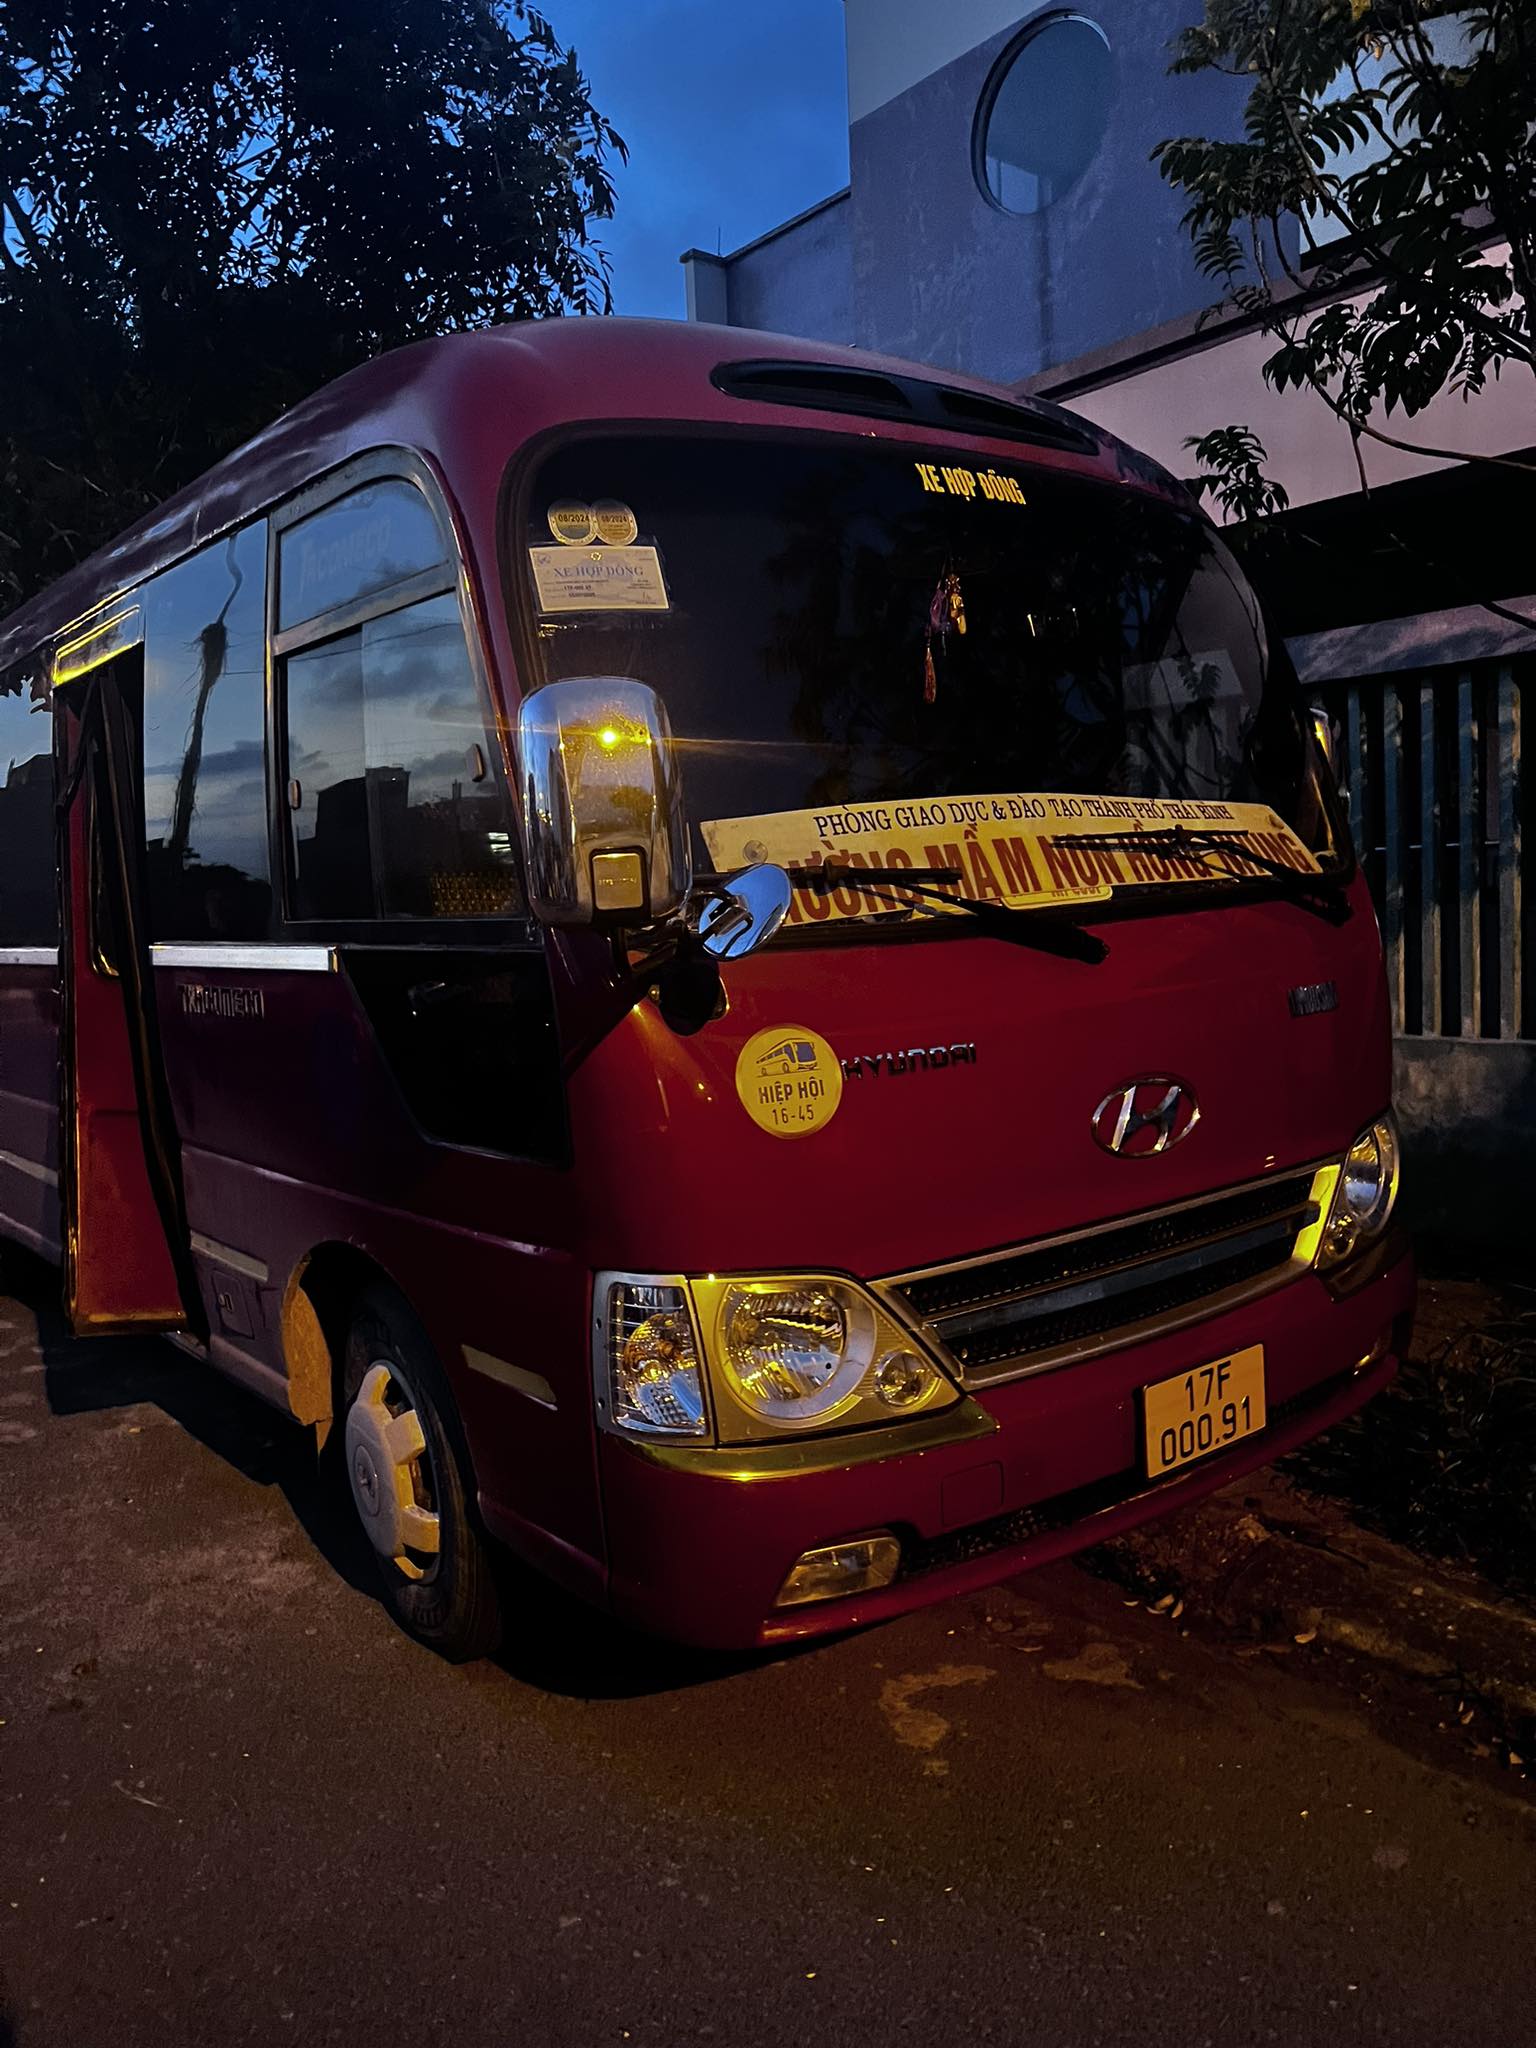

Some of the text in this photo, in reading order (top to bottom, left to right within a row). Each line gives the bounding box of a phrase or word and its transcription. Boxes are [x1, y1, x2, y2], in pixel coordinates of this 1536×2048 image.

[914, 463, 945, 493] XE
[940, 466, 976, 501] HỢP
[554, 567, 573, 577] XE
[813, 805, 892, 837] PHÒNG
[894, 804, 947, 829] GIAO
[947, 799, 989, 825] DỤC
[992, 800, 1007, 821] &
[1006, 795, 1046, 819] ĐÀO
[1049, 798, 1083, 820] TẠO
[1082, 796, 1137, 818] THÀNH
[1131, 799, 1166, 819] PHỐ
[1162, 800, 1199, 820] THÁI
[841, 1043, 977, 1081] HYUNDAI
[758, 1079, 825, 1105] HIỆP HỘI
[771, 1104, 815, 1125] 16-45
[1185, 1360, 1231, 1412] 17F
[1161, 1395, 1250, 1466] 000.91
